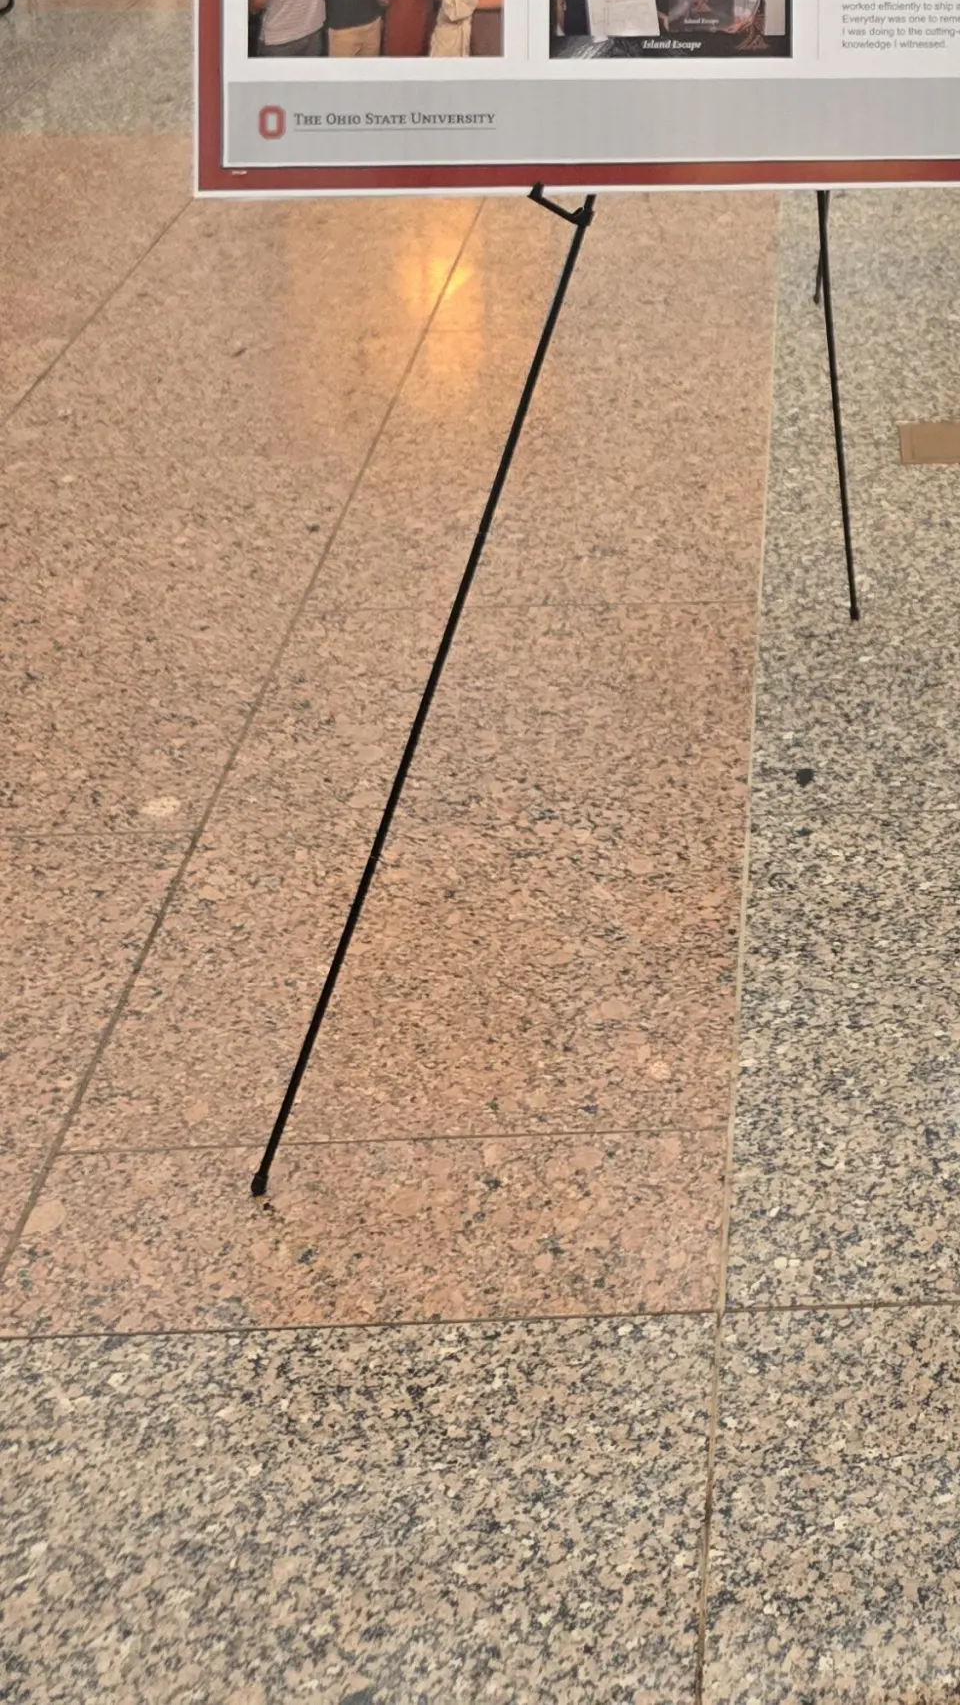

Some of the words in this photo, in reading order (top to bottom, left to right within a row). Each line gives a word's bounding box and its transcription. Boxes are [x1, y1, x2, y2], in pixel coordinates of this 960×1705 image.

[842, 1, 875, 10] worked
[877, 1, 920, 13] efficiently
[934, 1, 953, 13] ship
[643, 39, 671, 49] Island
[672, 39, 702, 52] Escape
